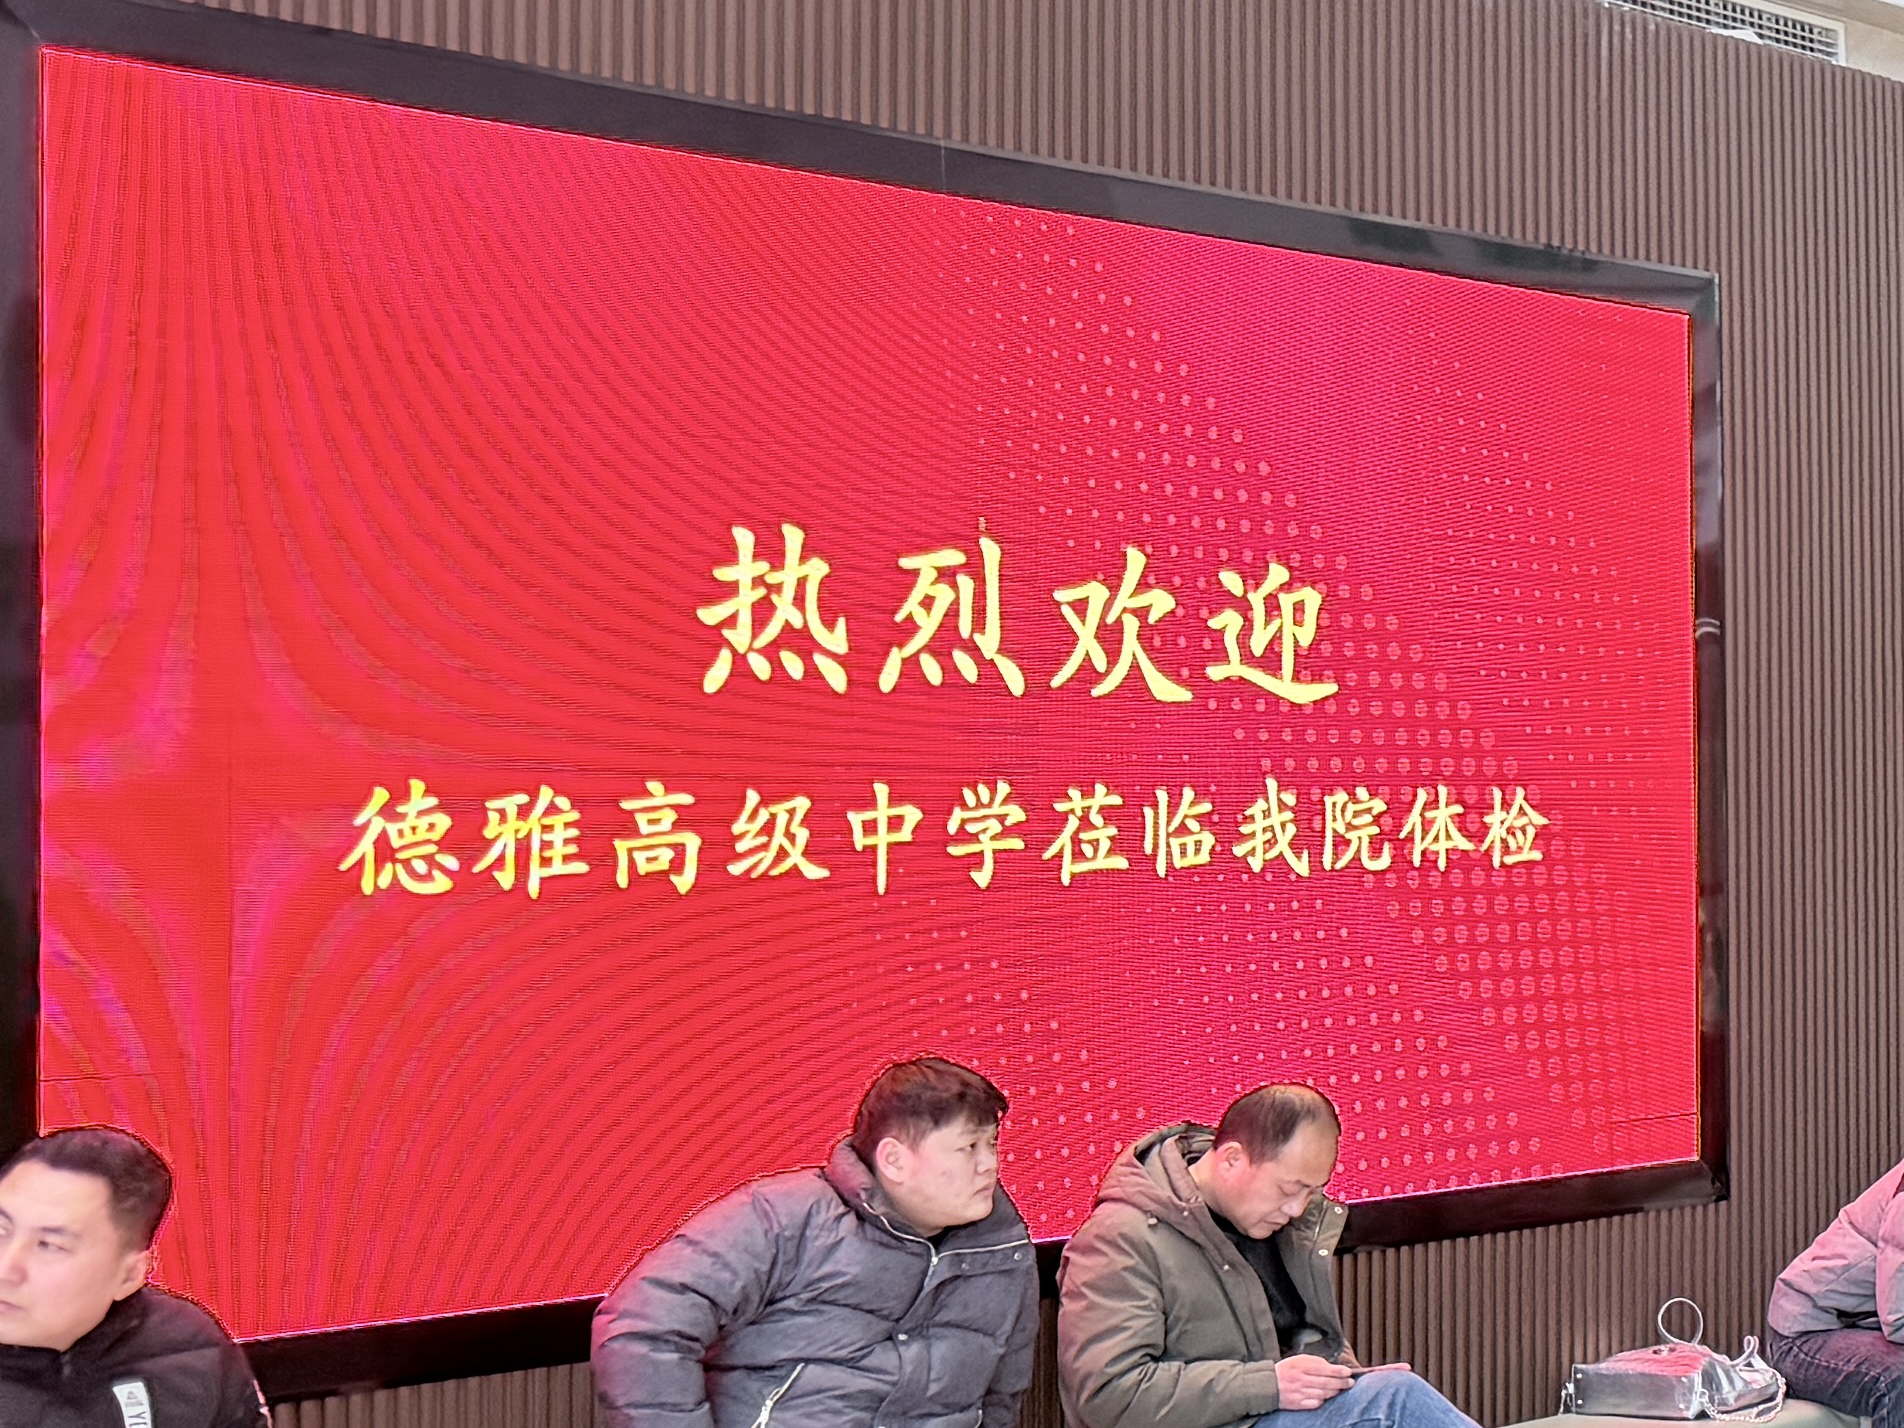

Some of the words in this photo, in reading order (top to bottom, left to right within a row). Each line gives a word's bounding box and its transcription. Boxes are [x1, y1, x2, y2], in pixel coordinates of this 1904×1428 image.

[698, 524, 1337, 705] 热烈欢迎
[337, 775, 1551, 901] 德雅高级中学莅临我院体检
